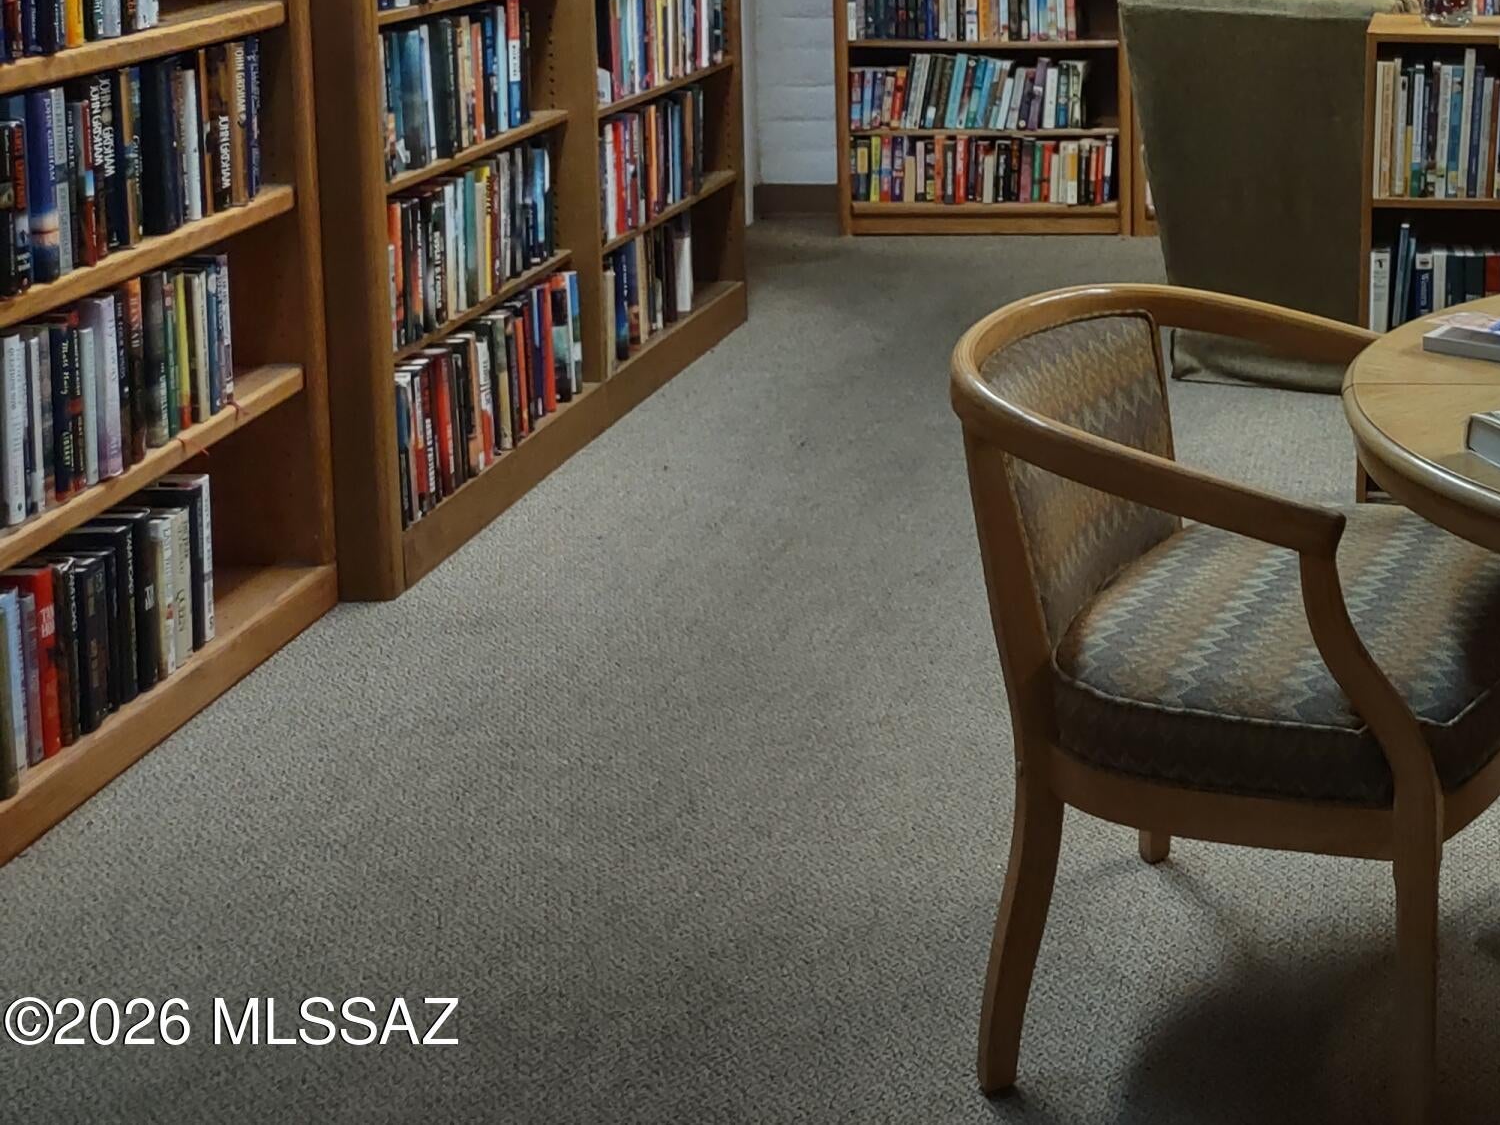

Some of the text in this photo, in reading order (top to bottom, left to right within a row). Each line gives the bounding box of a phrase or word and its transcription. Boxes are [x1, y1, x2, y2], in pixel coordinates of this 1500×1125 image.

[234, 47, 246, 113] JOHN GRISHAM
[44, 98, 56, 180] JOHN GRISHAM
[90, 85, 103, 165] JOHN GRISHAM
[99, 78, 115, 176] JOHN GRISHAM
[218, 116, 231, 188] JOHN GRISHAM
[130, 299, 140, 348] HANNAH
[1420, 273, 1429, 306] Western
[60, 341, 71, 465] Matt Haig LIBRARY
